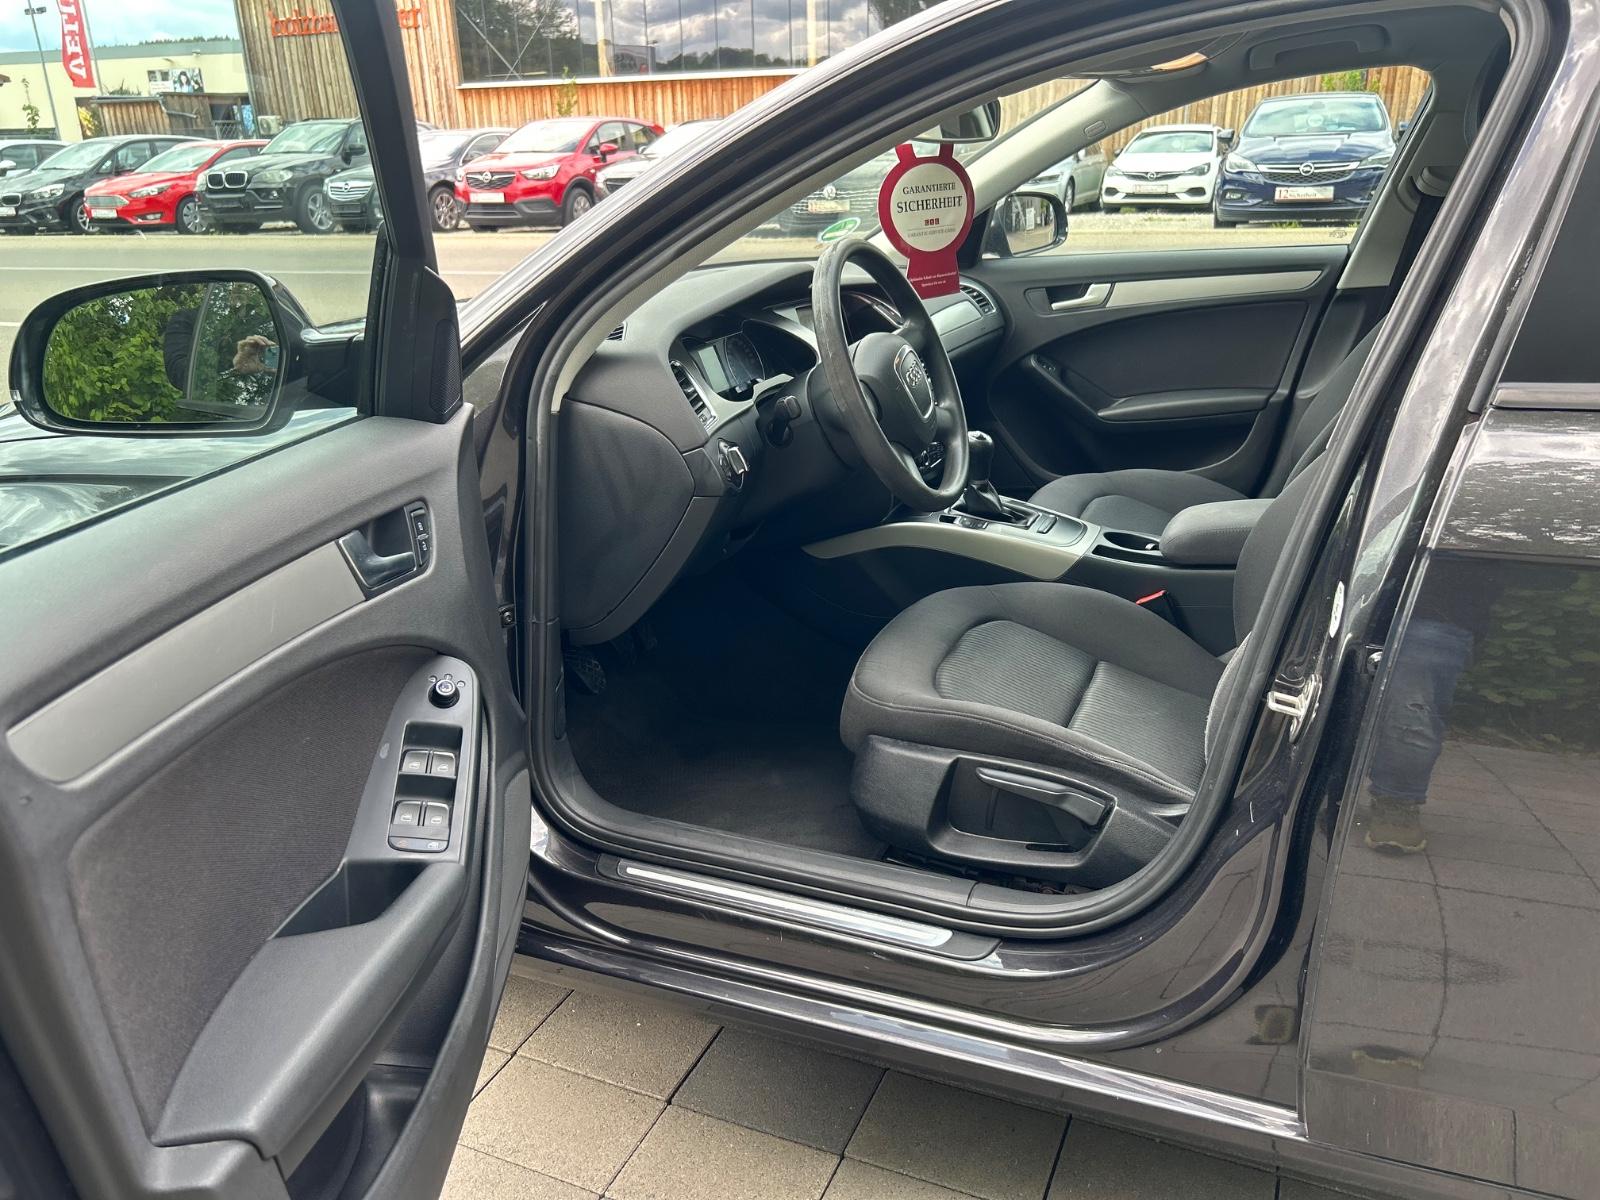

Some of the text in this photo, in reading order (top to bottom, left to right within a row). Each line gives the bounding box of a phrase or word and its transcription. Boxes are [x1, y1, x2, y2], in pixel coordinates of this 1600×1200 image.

[902, 182, 956, 195] GARANTIERTE
[1278, 189, 1289, 199] 12
[896, 195, 963, 214] SICHERHEIT
